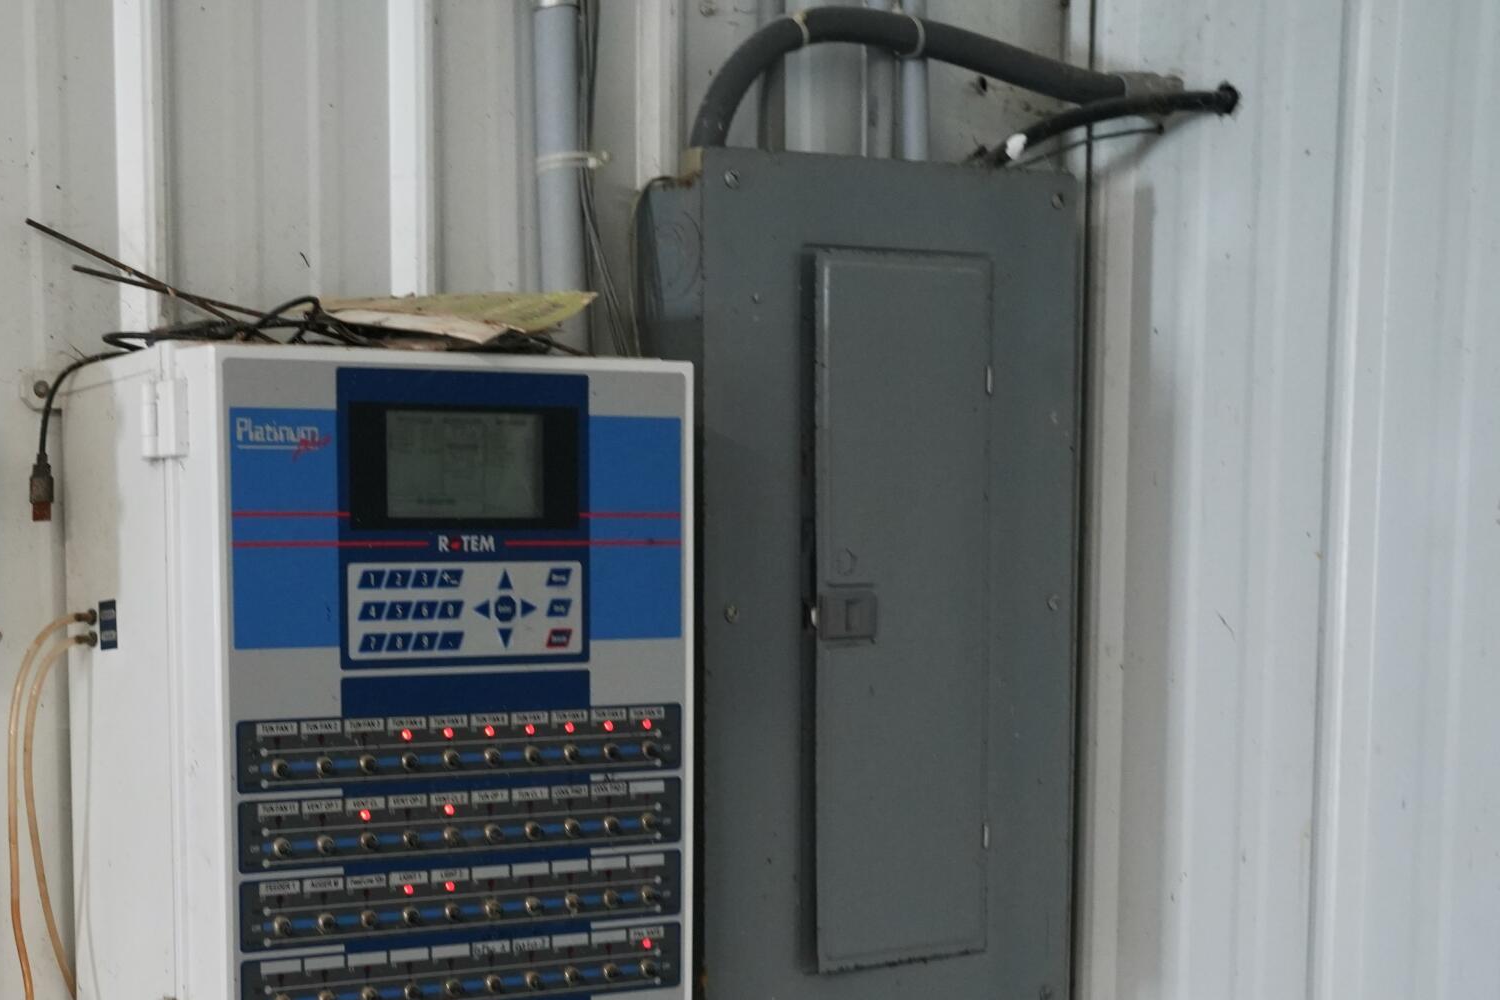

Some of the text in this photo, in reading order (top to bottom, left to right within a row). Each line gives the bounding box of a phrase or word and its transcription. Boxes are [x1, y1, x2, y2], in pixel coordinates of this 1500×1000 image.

[236, 417, 319, 442] Platinum
[369, 572, 375, 586] 1
[422, 572, 428, 586] 3
[369, 604, 376, 618] 4
[421, 604, 428, 618] 6
